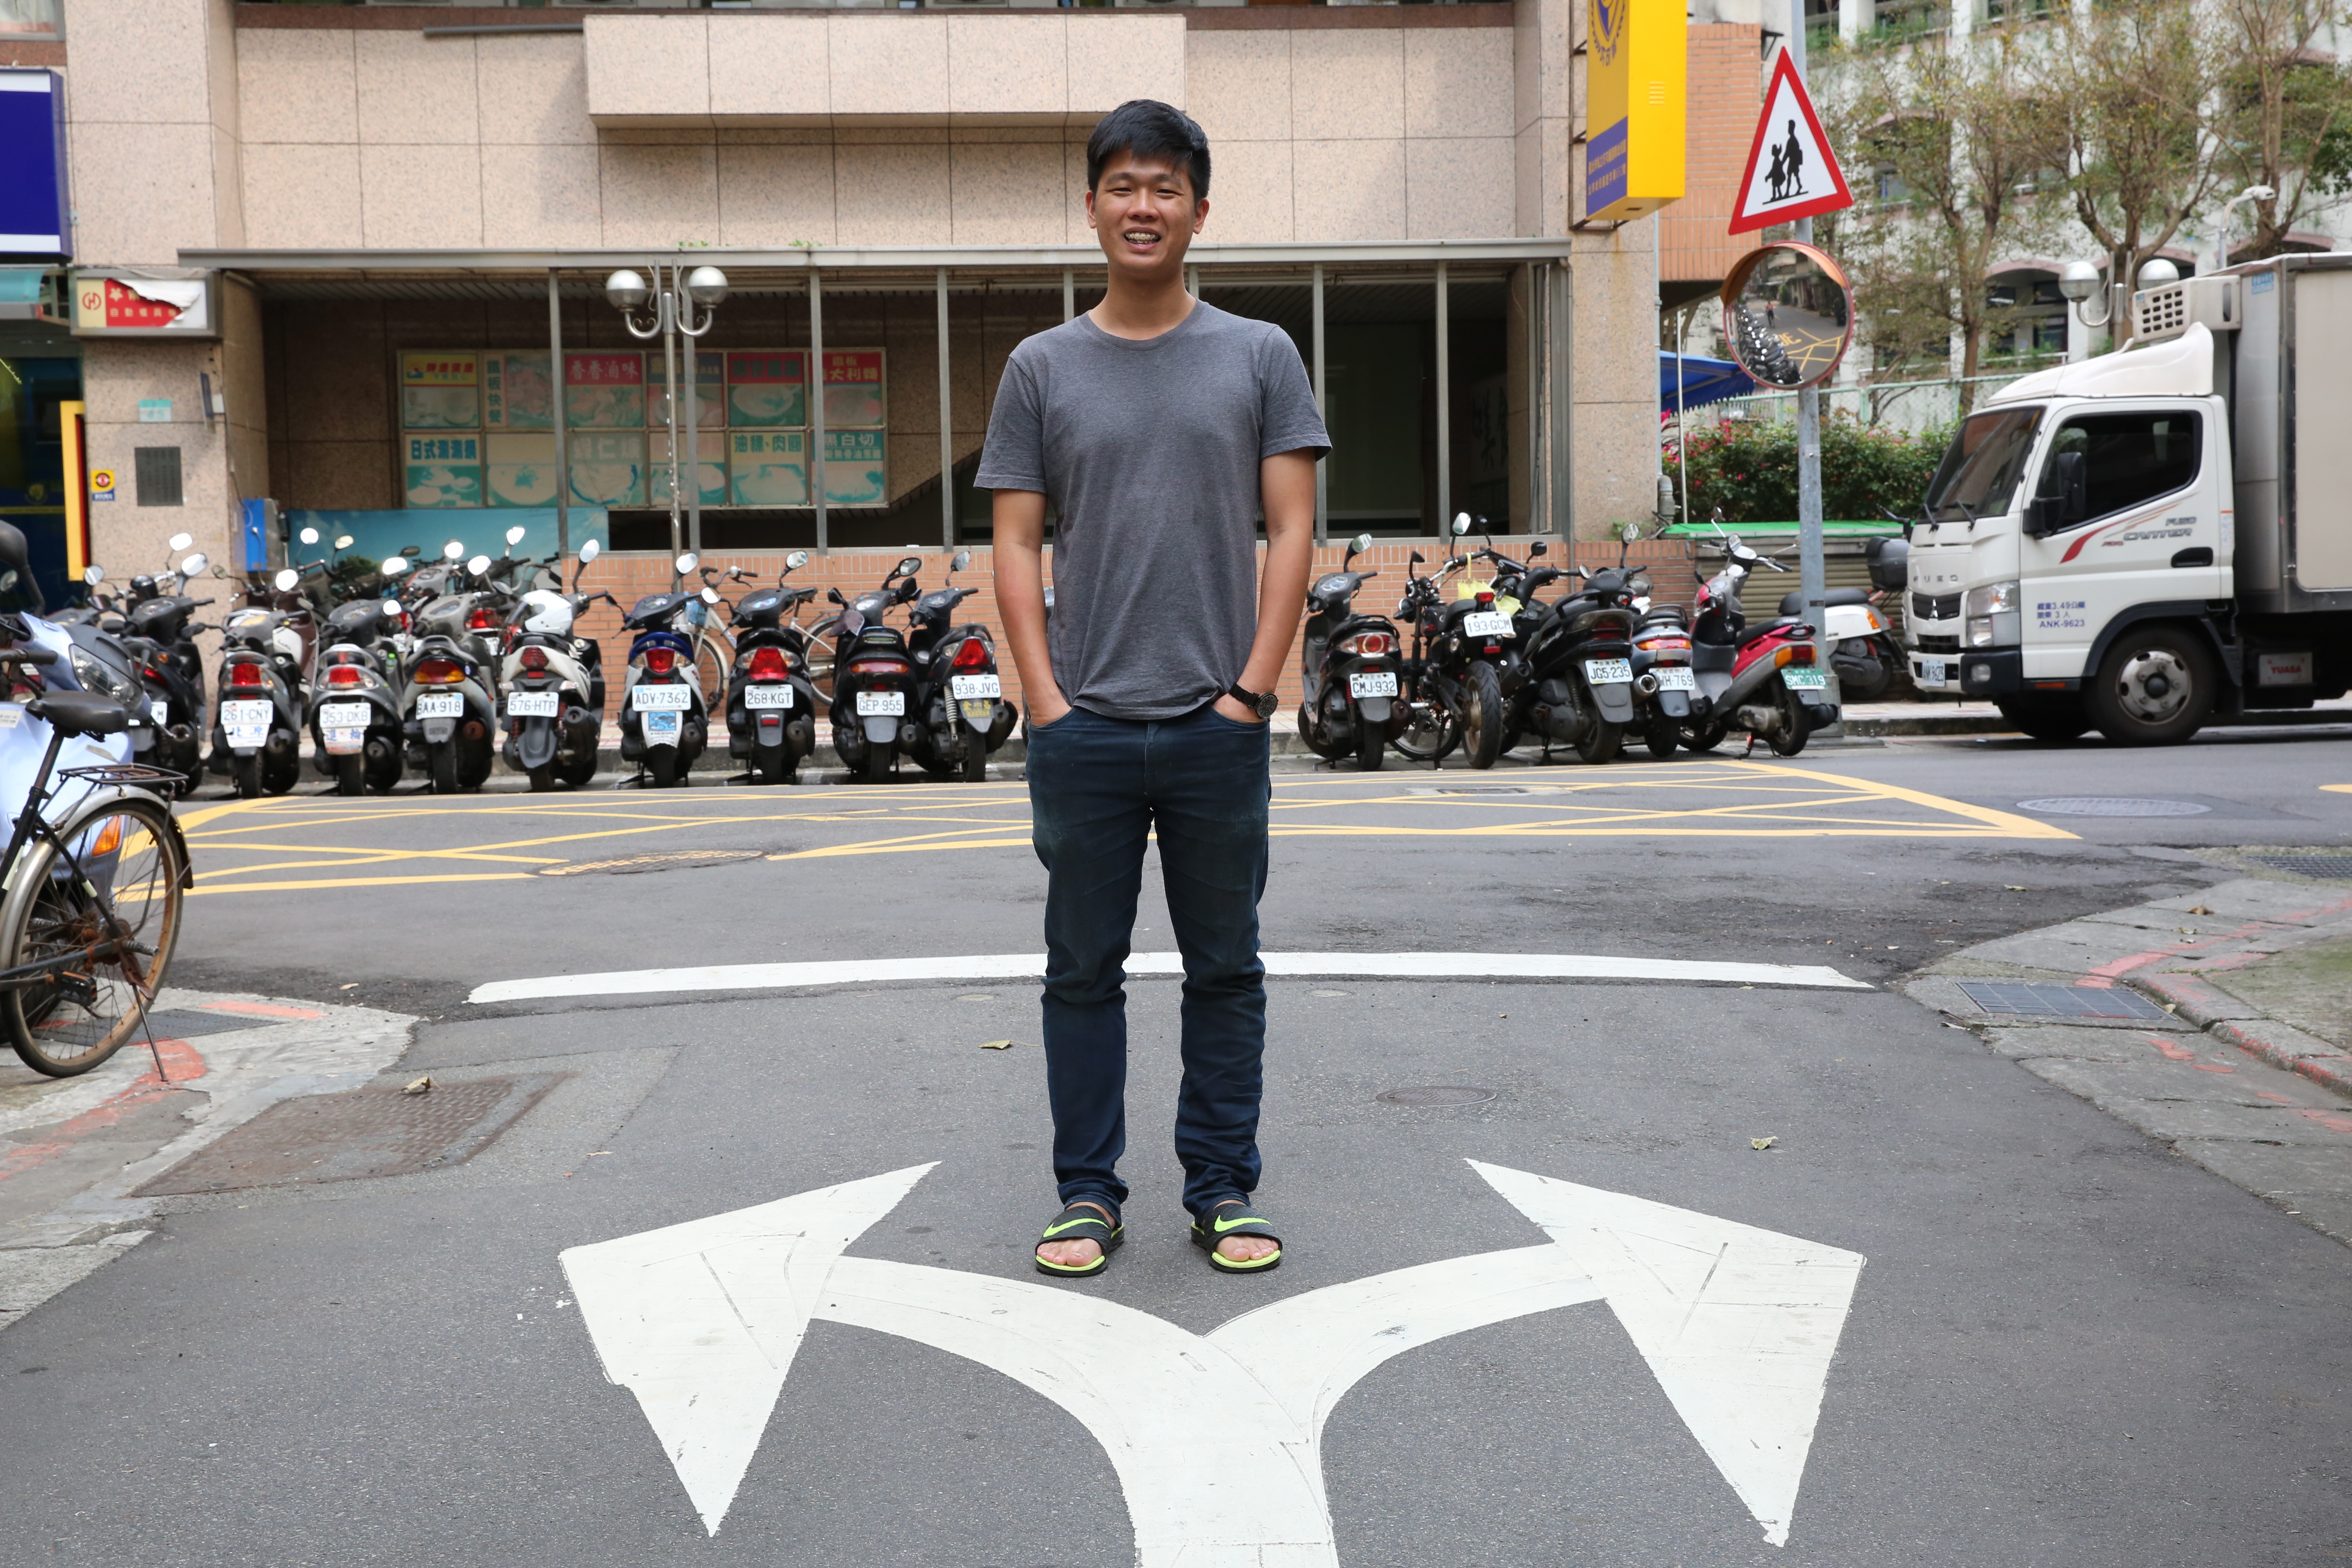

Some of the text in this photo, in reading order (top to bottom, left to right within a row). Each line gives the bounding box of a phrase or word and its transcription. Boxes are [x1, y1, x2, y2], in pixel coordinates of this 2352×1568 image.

[825, 433, 874, 446] 黑白切
[2124, 528, 2192, 541] CANTER
[1468, 619, 1511, 633] 193-GCM
[2040, 619, 2085, 628] ANK-9623
[955, 682, 998, 695] 938-JVG
[1353, 681, 1396, 693] CMJ-932
[635, 692, 688, 704] ADV-7362
[747, 693, 791, 704] 268-KGT
[416, 701, 461, 715] BAA-918
[510, 700, 556, 712] 576-HTP
[859, 700, 902, 711] GEP-955
[224, 708, 270, 721] 261-CNY
